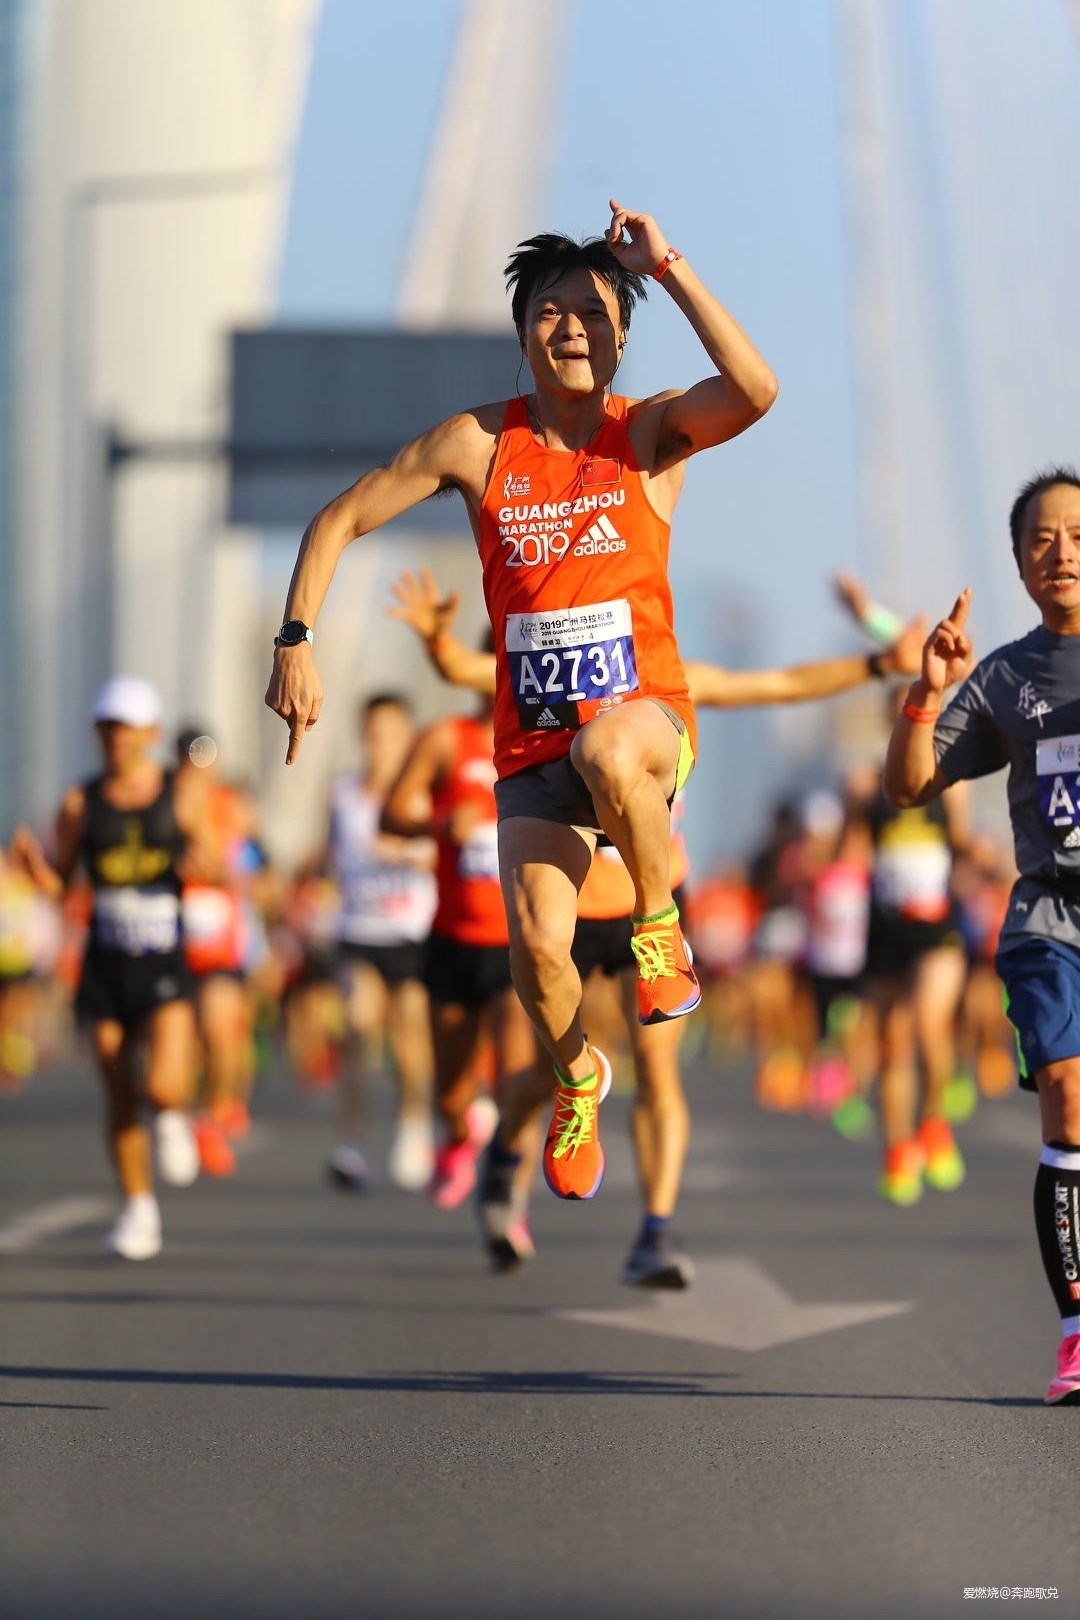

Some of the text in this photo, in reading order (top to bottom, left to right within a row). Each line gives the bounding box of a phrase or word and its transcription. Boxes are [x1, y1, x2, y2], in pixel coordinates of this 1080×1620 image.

[499, 489, 626, 522] GUANGZHOU
[499, 518, 573, 536] MARATHON
[501, 531, 570, 567] 2019
[574, 539, 627, 557] adidas
[586, 620, 615, 630] MARATHON
[519, 641, 628, 695] A2731
[537, 719, 560, 727] adidas
[1048, 775, 1080, 817] A
